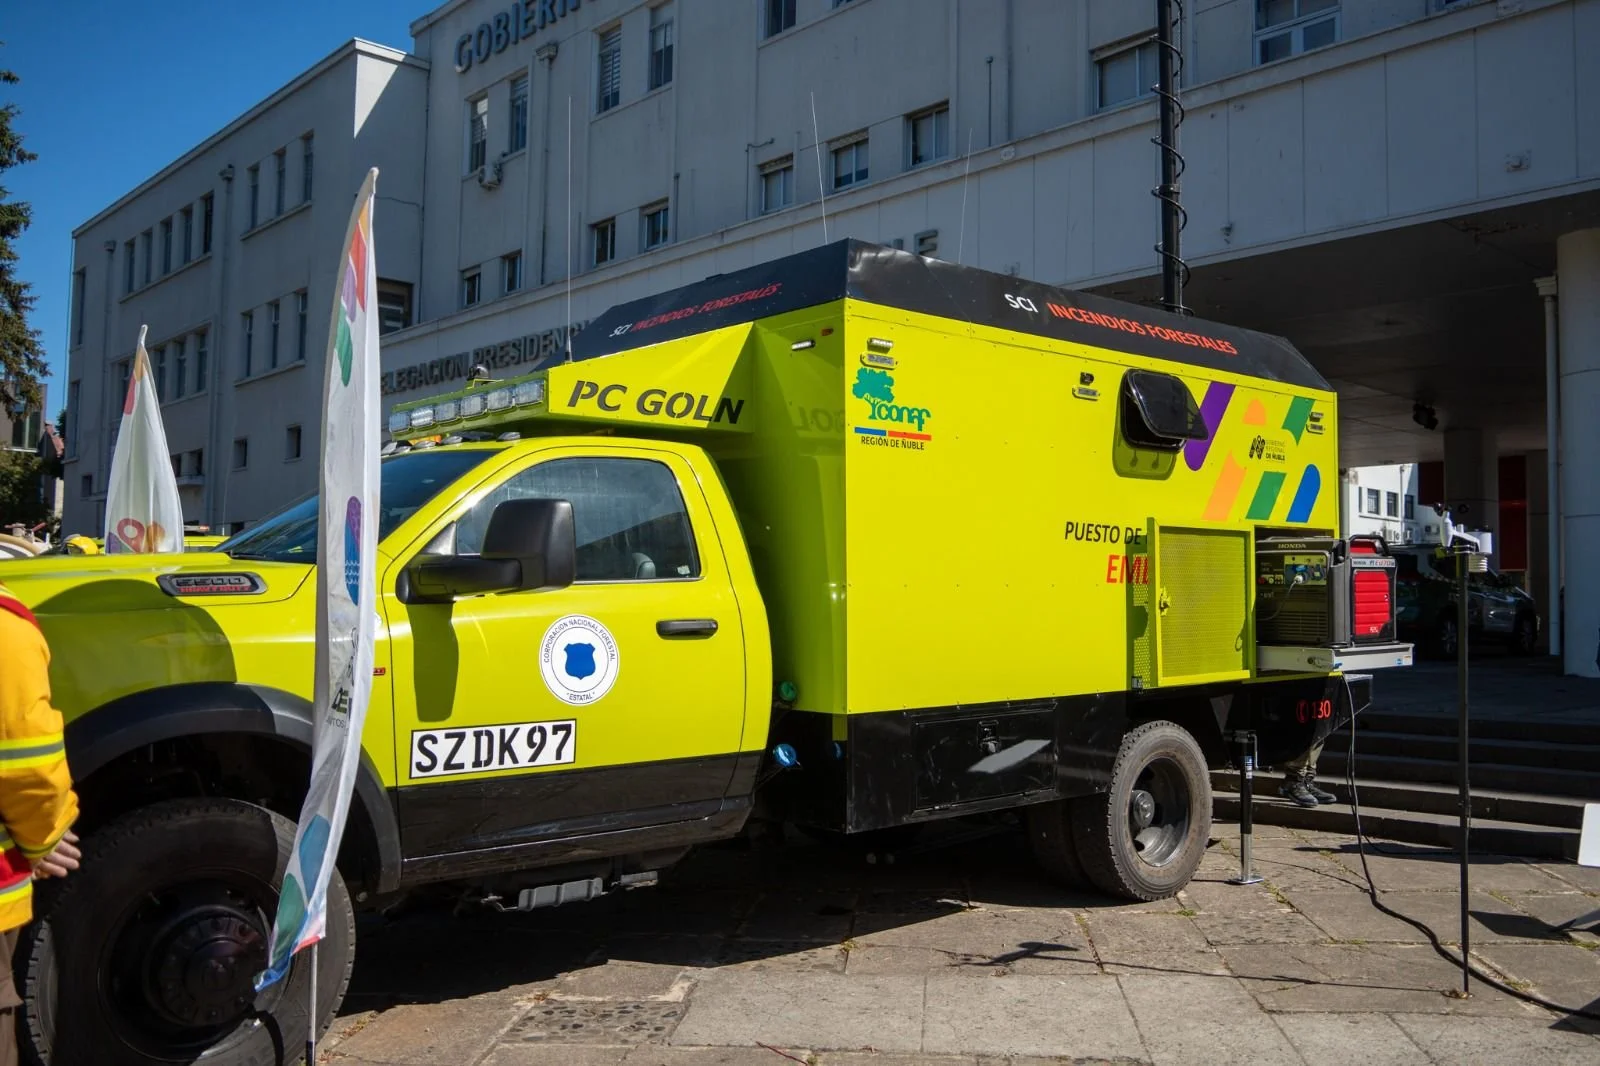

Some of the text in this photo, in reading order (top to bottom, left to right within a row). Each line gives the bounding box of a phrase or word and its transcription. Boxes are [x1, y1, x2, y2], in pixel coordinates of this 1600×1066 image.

[1004, 293, 1238, 356] SCI INCENDIOS FORESTALES
[567, 380, 745, 424] PC GOLN
[861, 435, 925, 451] REGIÓN DE ÑUBLE
[1064, 521, 1143, 545] PUESTO DE
[568, 618, 599, 632] NACIONAL
[598, 629, 616, 662] FORESTAL
[415, 723, 573, 773] SZDK97
